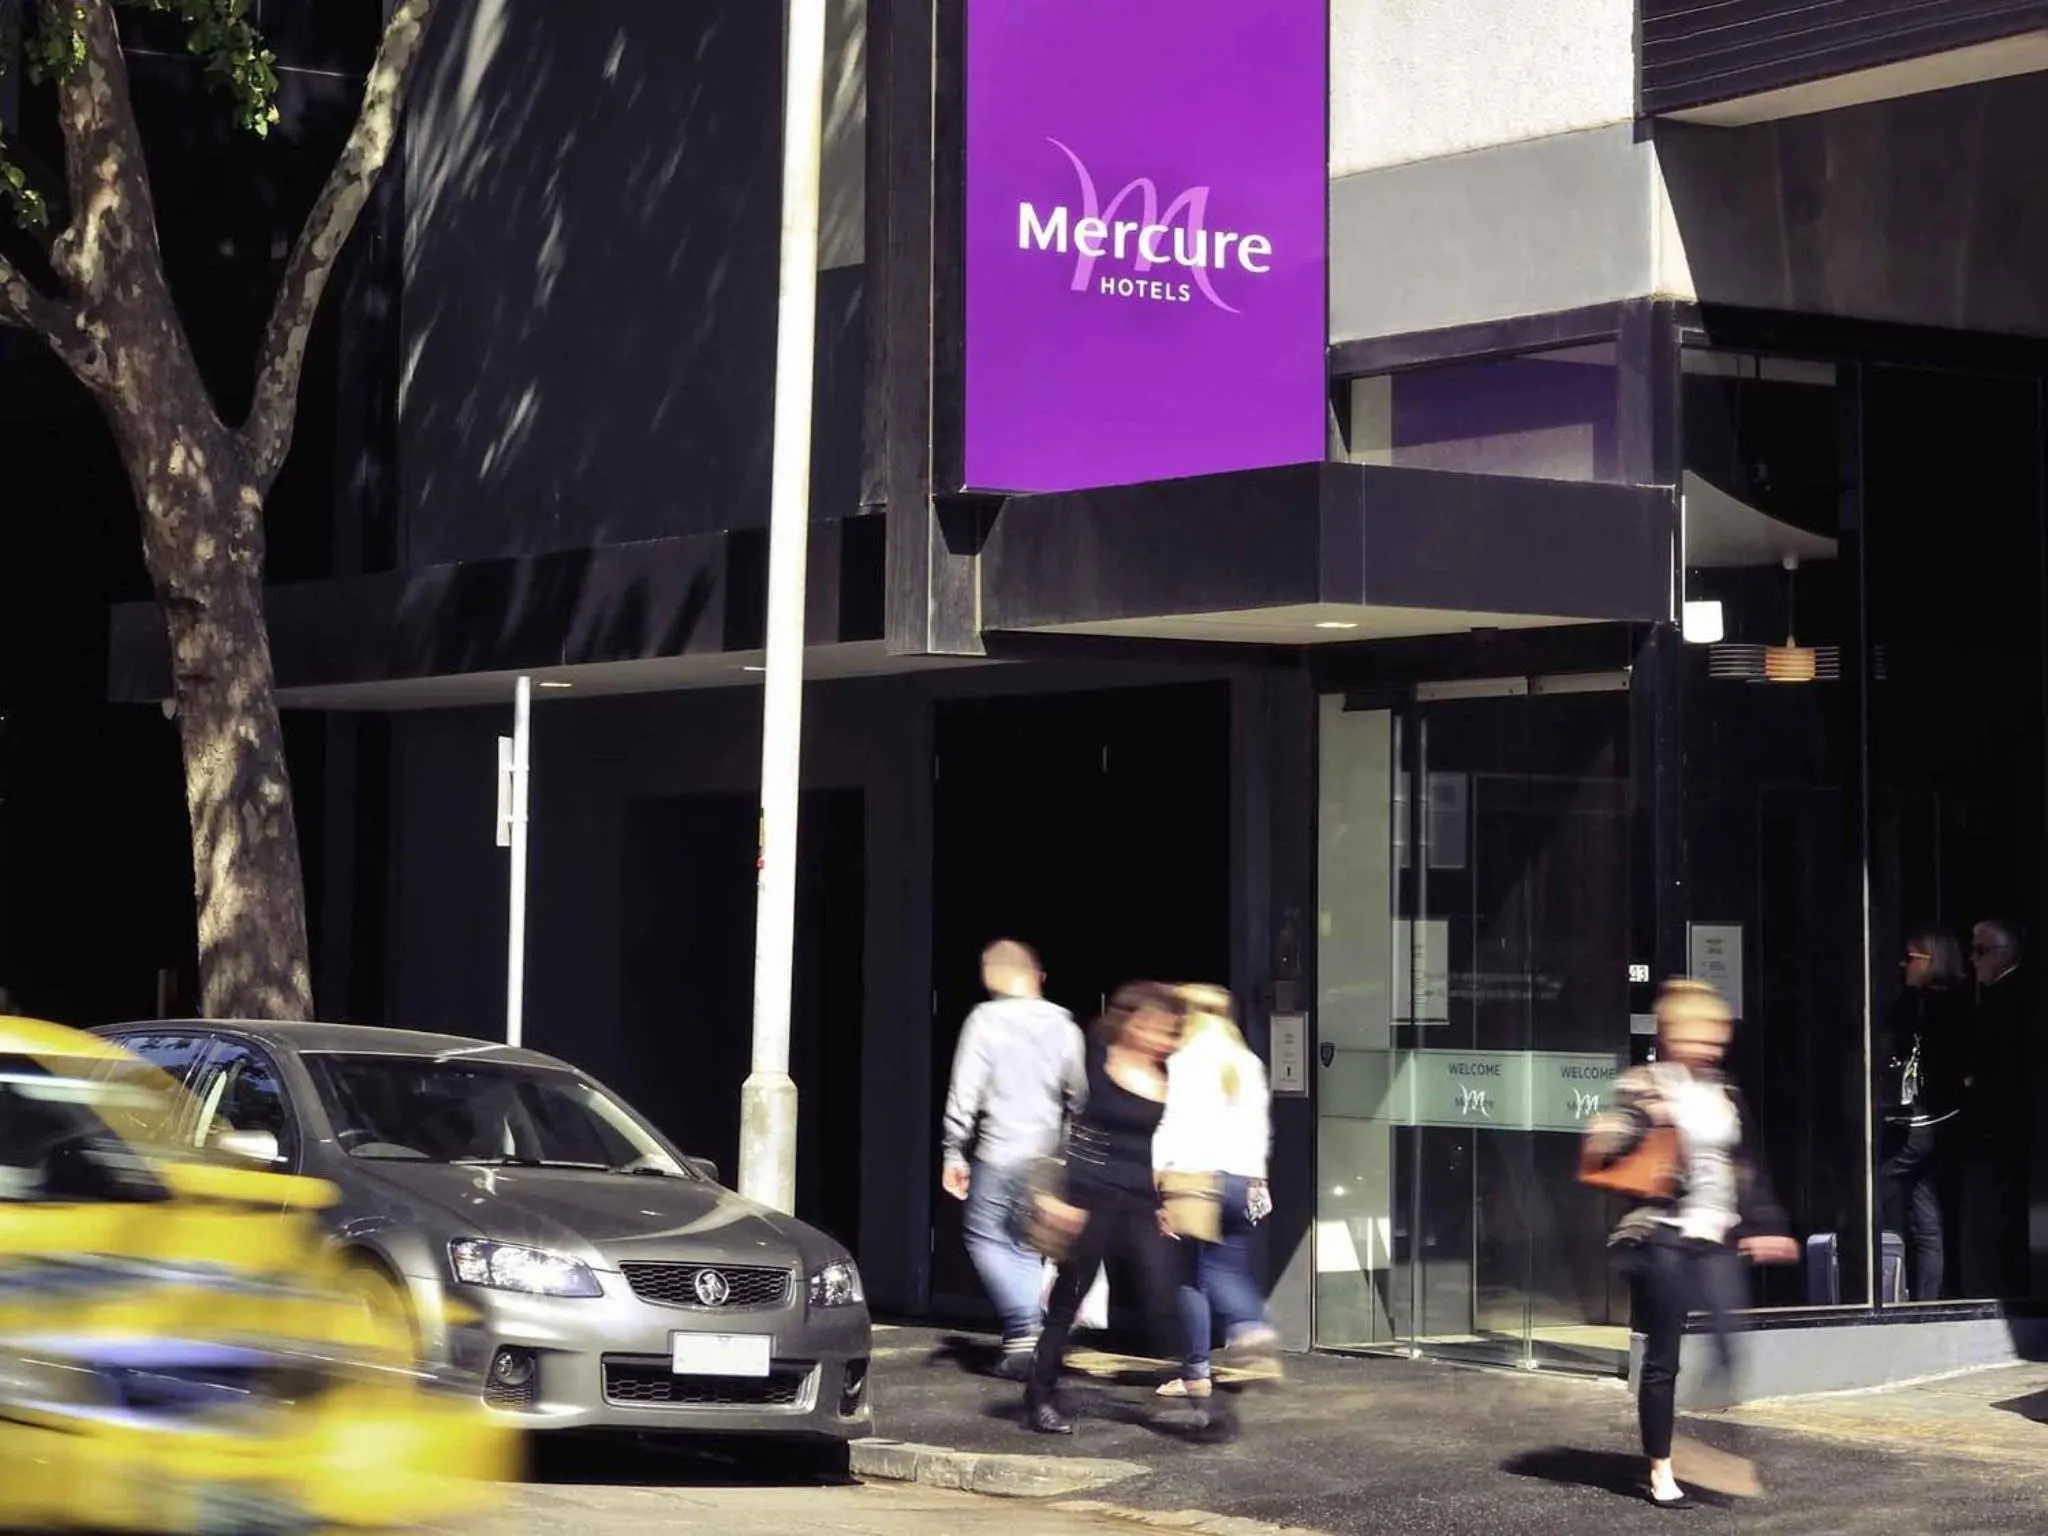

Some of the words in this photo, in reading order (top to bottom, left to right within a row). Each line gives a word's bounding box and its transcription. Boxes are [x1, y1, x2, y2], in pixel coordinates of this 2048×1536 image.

[1018, 201, 1272, 274] Mercure
[1100, 275, 1191, 302] HOTELS
[1448, 1062, 1500, 1077] WELCOME
[1561, 1066, 1616, 1081] WELCOME
